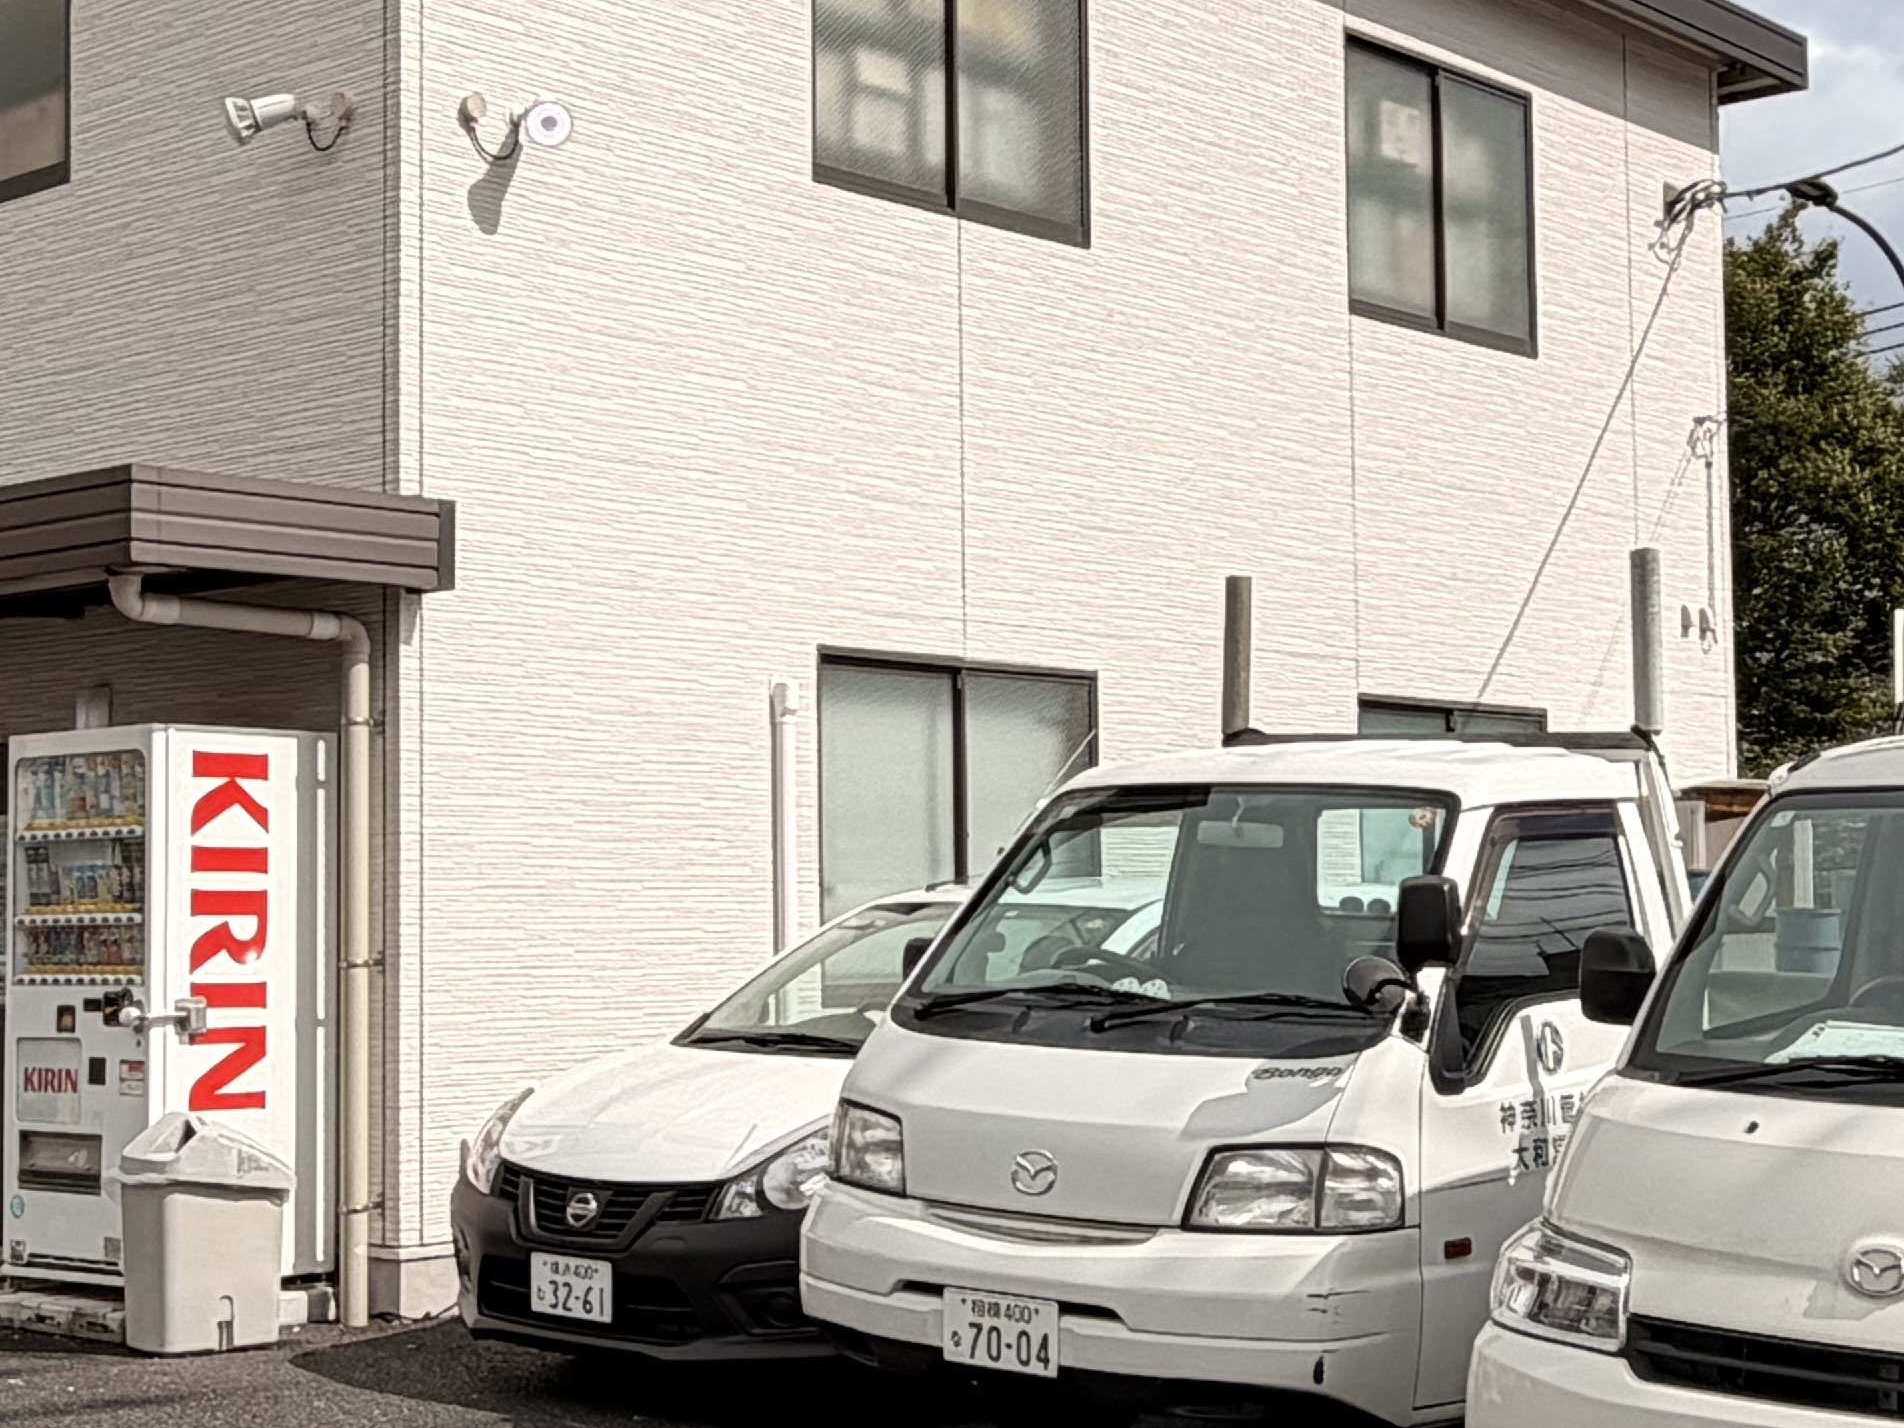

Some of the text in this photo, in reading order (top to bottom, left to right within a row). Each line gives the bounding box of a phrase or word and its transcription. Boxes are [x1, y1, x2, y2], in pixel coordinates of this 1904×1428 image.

[189, 749, 269, 1112] KIRIN
[23, 1066, 79, 1094] KIRIN
[1499, 1091, 1585, 1134] 神奈川管
[548, 1279, 604, 1317] 32-61
[968, 1321, 1051, 1371] 70-04
